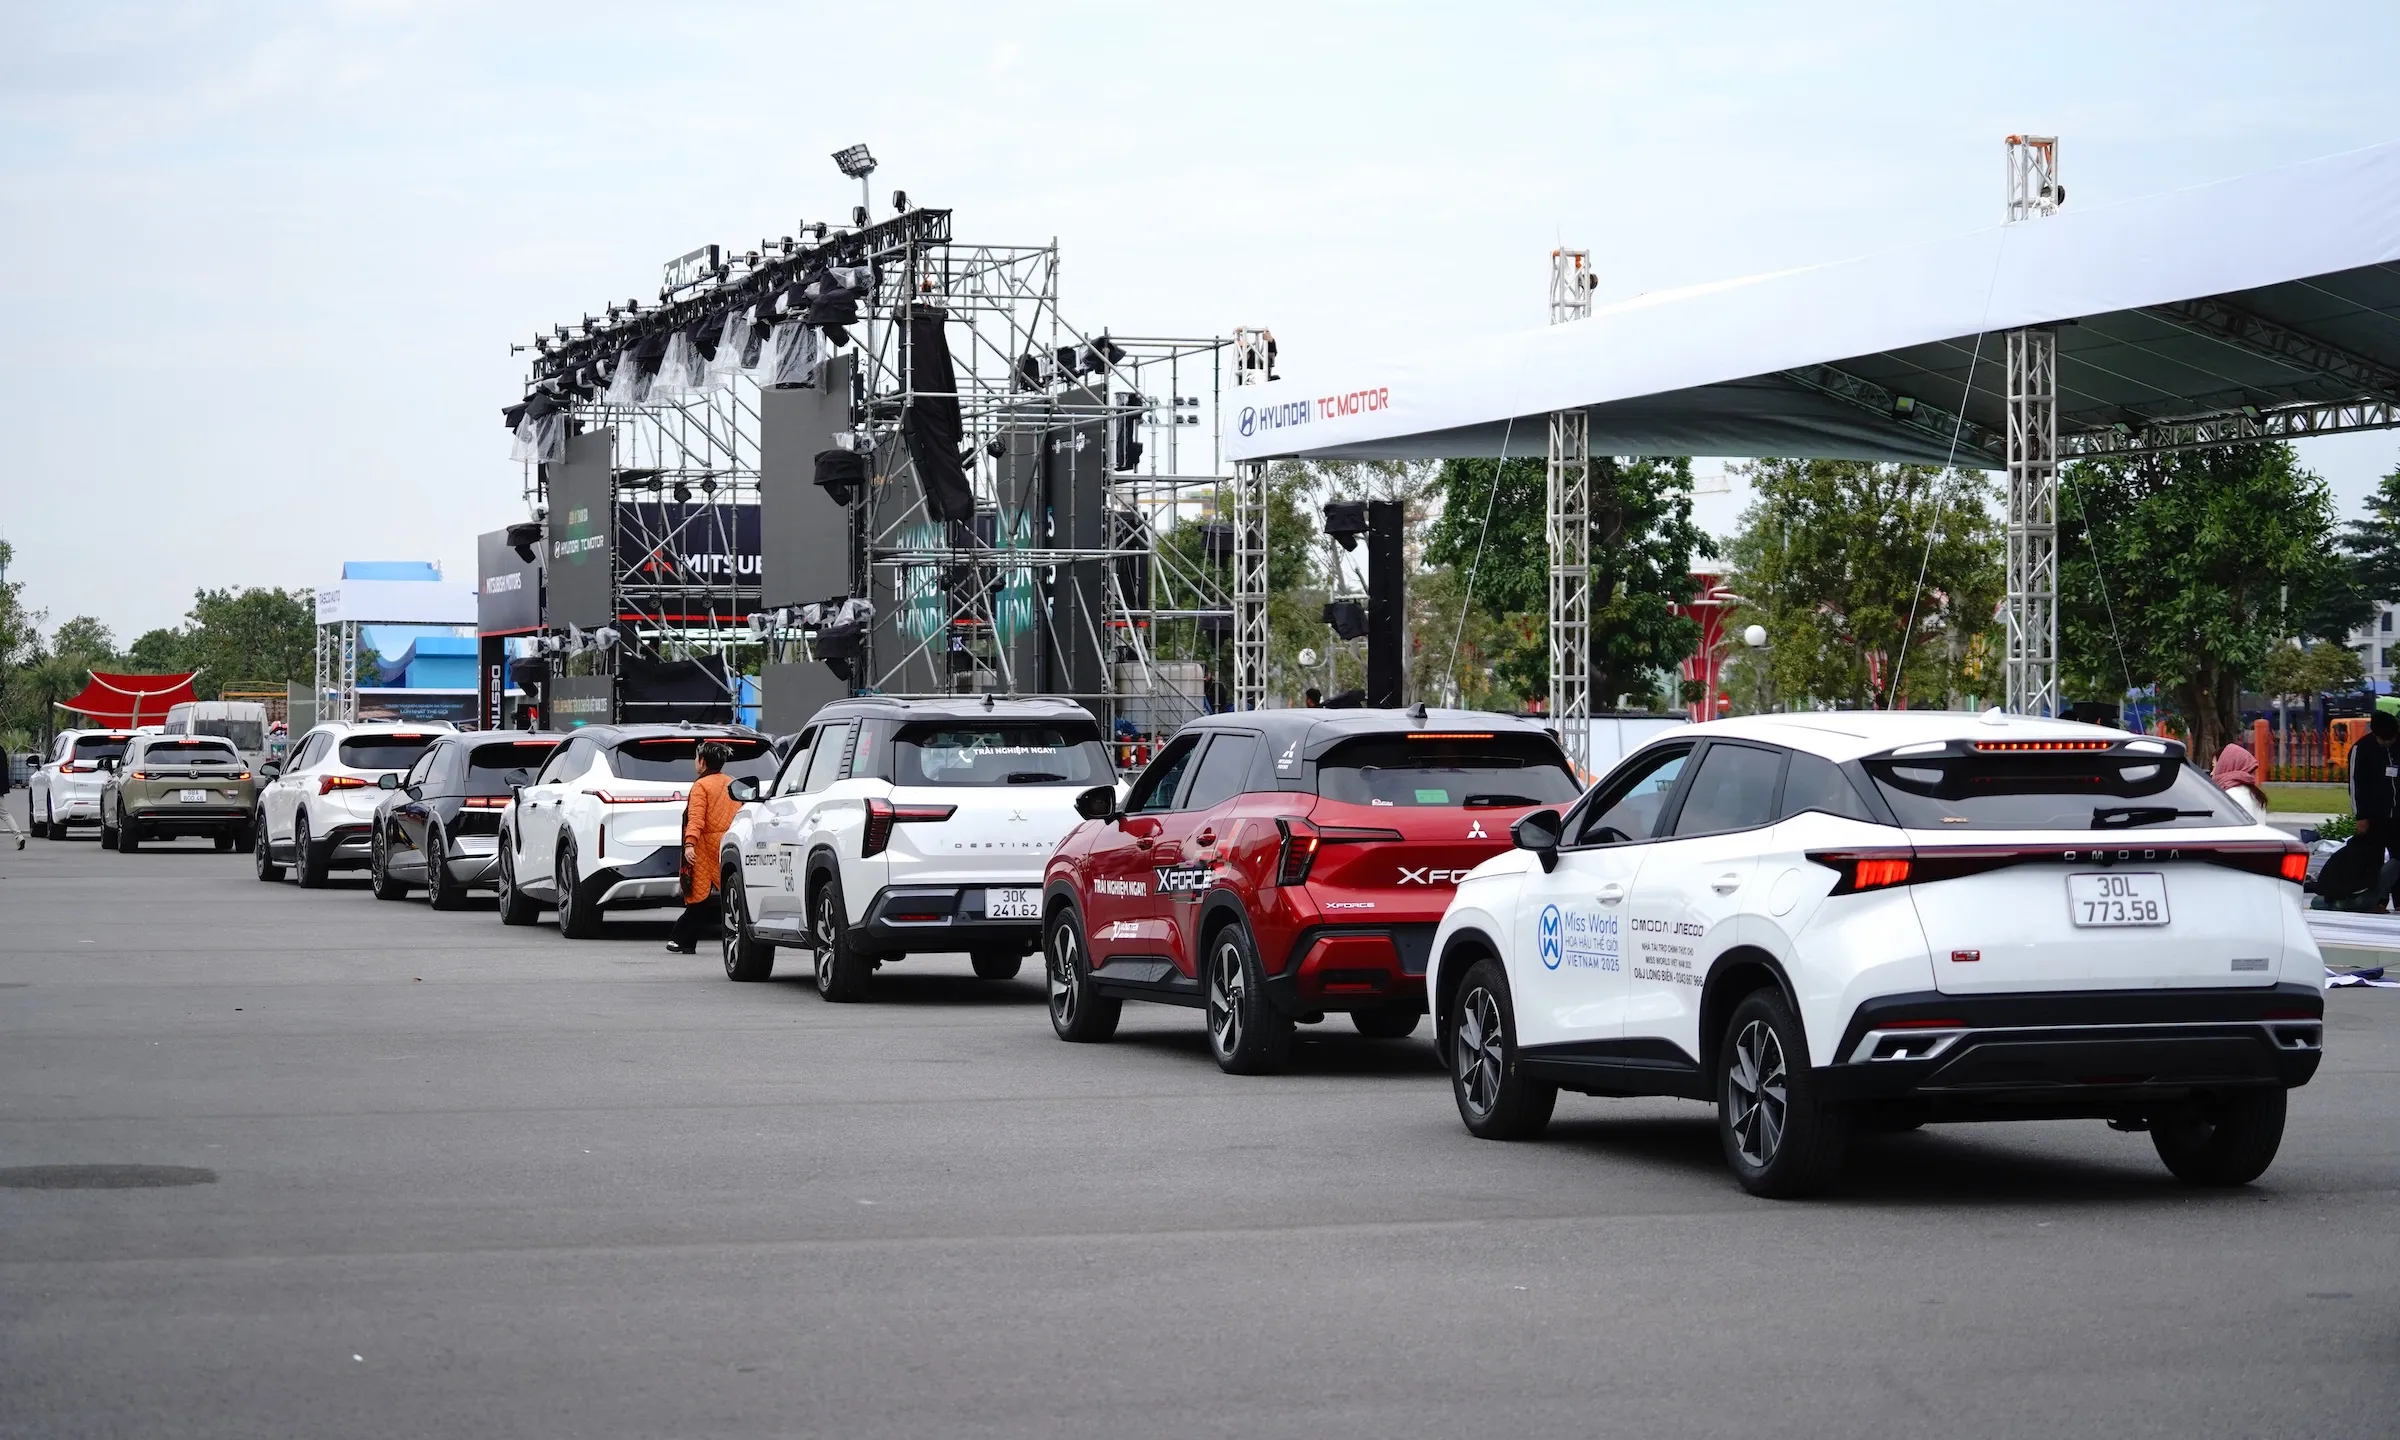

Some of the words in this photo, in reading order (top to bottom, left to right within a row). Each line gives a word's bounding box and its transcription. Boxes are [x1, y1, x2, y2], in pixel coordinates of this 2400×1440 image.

[1260, 400, 1310, 430] HYUNDAI
[561, 539, 579, 555] HYUNDAI
[491, 664, 501, 731] DESTIN
[745, 854, 777, 866] DESTINATOR
[2064, 849, 2180, 861] OMODA
[1128, 880, 1147, 896] NGAY!
[1156, 868, 1212, 892] XFORCE
[2097, 877, 2139, 898] 30L
[1003, 890, 1027, 903] 30K
[993, 904, 1038, 917] 241.62
[2083, 901, 2159, 922] 773.58
[1565, 911, 1586, 932] Miss
[1588, 913, 1618, 935] World
[1632, 918, 1669, 933] OMODA
[1566, 935, 1578, 948] HOA
[1567, 954, 1600, 969] VIETNAM
[1601, 957, 1620, 972] 2025
[1646, 969, 1660, 981] LONG
[1662, 968, 1673, 982] BIÊN
